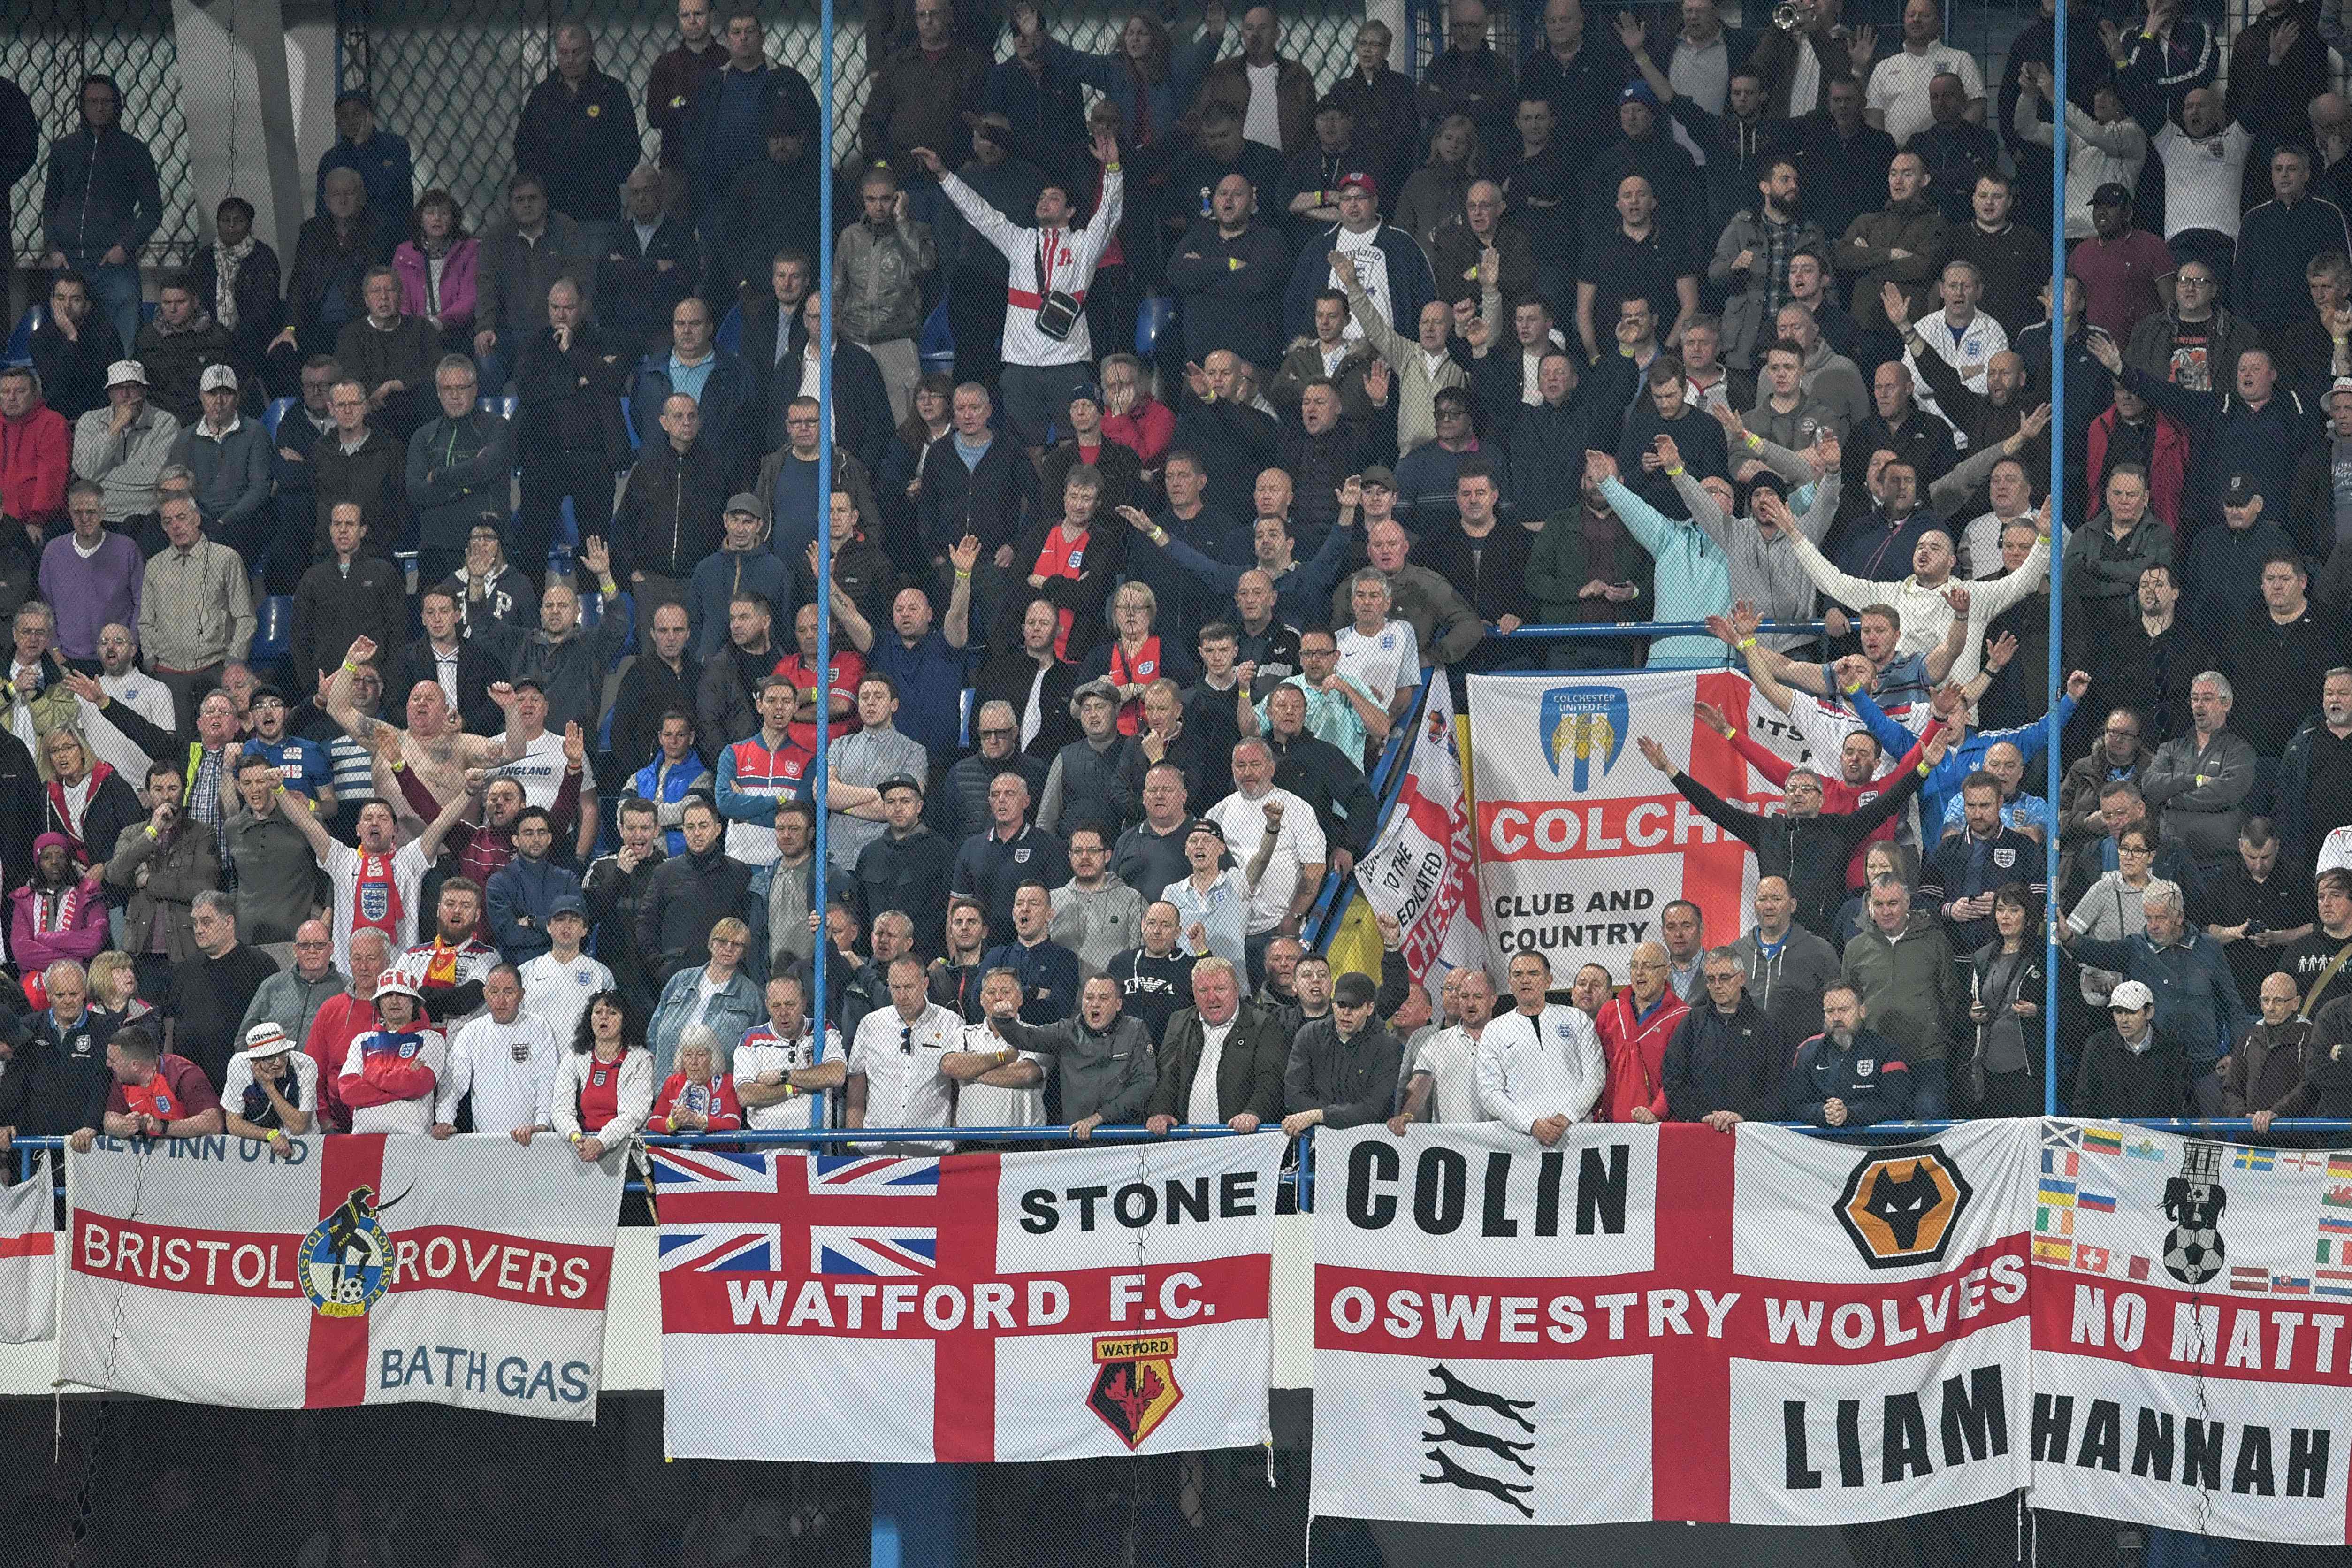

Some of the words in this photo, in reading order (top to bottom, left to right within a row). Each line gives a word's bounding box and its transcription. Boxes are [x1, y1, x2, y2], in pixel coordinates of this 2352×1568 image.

[1553, 694, 1616, 703] COLCHESTER
[498, 766, 552, 776] ENGLAND
[1383, 871, 1401, 893] TO
[1393, 842, 1413, 876] THE
[1398, 852, 1443, 928] EDICATED
[1495, 893, 1574, 918] CLUB
[1585, 888, 1654, 913] AND
[1499, 922, 1650, 953] COUNTRY
[169, 1134, 226, 1162] INN
[1019, 1171, 1259, 1235] STONE
[1345, 1140, 1630, 1238] COLIN
[84, 1223, 294, 1289] BRISTOL
[392, 1236, 590, 1299] ROVERS
[301, 1229, 325, 1297] BRISTOL
[371, 1225, 393, 1288] ROVERS
[726, 1279, 1070, 1331] WATFORD
[1108, 1272, 1216, 1322] F.C.
[1330, 1285, 1741, 1345] OSWESTRY
[1764, 1253, 2027, 1350] WOLVES
[2070, 1284, 2148, 1353] NO
[2169, 1302, 2352, 1375] MATT
[380, 1345, 487, 1393] BATH
[496, 1356, 590, 1403] GAS
[1102, 1341, 1168, 1357] WATFORD
[1783, 1364, 2008, 1490] LIAM
[2031, 1392, 2330, 1498] HANNAH
